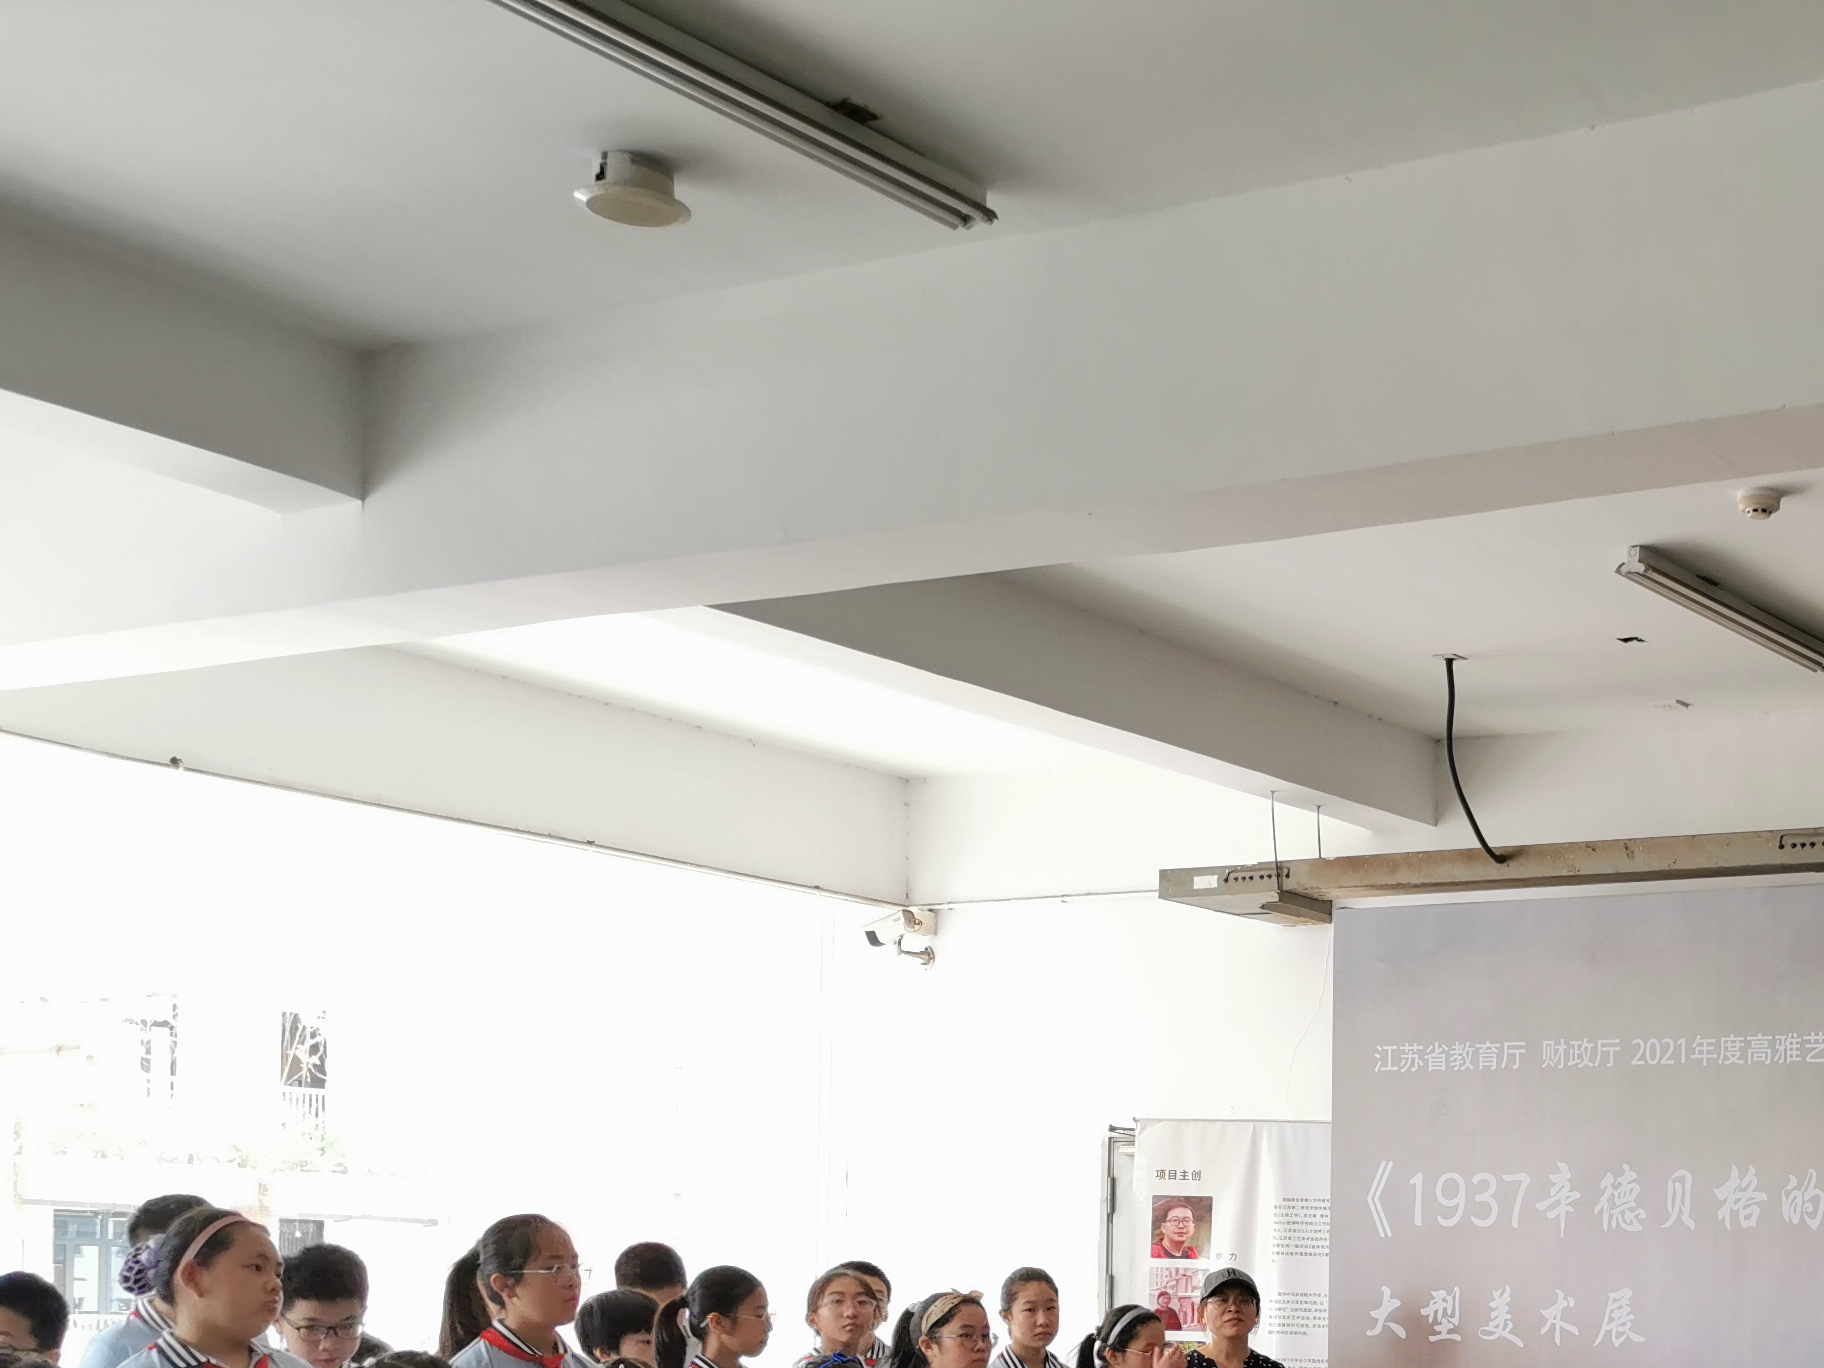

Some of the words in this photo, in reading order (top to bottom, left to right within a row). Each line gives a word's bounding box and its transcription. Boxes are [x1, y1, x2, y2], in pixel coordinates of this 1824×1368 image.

[1373, 1041, 1526, 1073] 江苏省教育厅
[1541, 1037, 1621, 1069] 财政厅
[1155, 1169, 1202, 1182] 项目主创
[1365, 1284, 1647, 1348] 大型美术展
